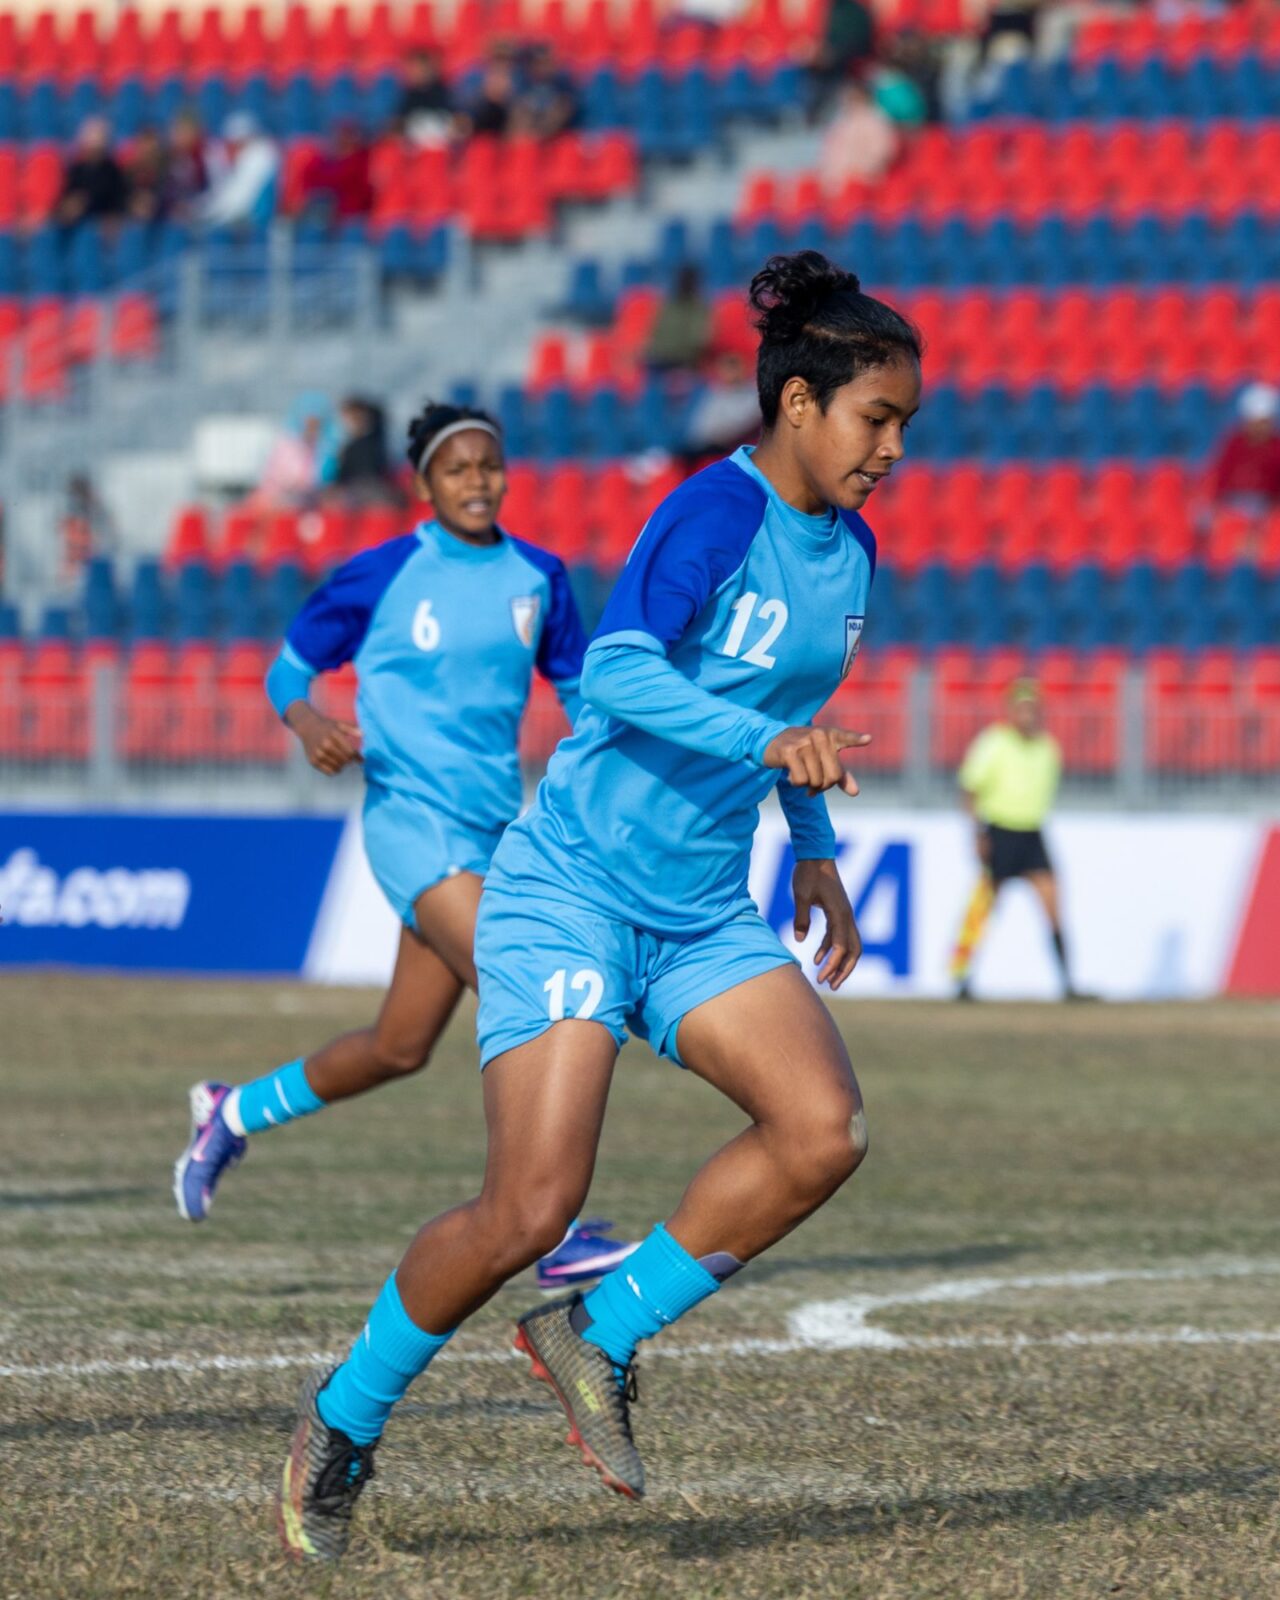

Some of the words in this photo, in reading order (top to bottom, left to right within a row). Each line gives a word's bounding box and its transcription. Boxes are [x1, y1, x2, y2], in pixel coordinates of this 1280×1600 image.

[412, 600, 440, 651] 6
[721, 591, 788, 670] 12
[543, 968, 604, 1021] 12
